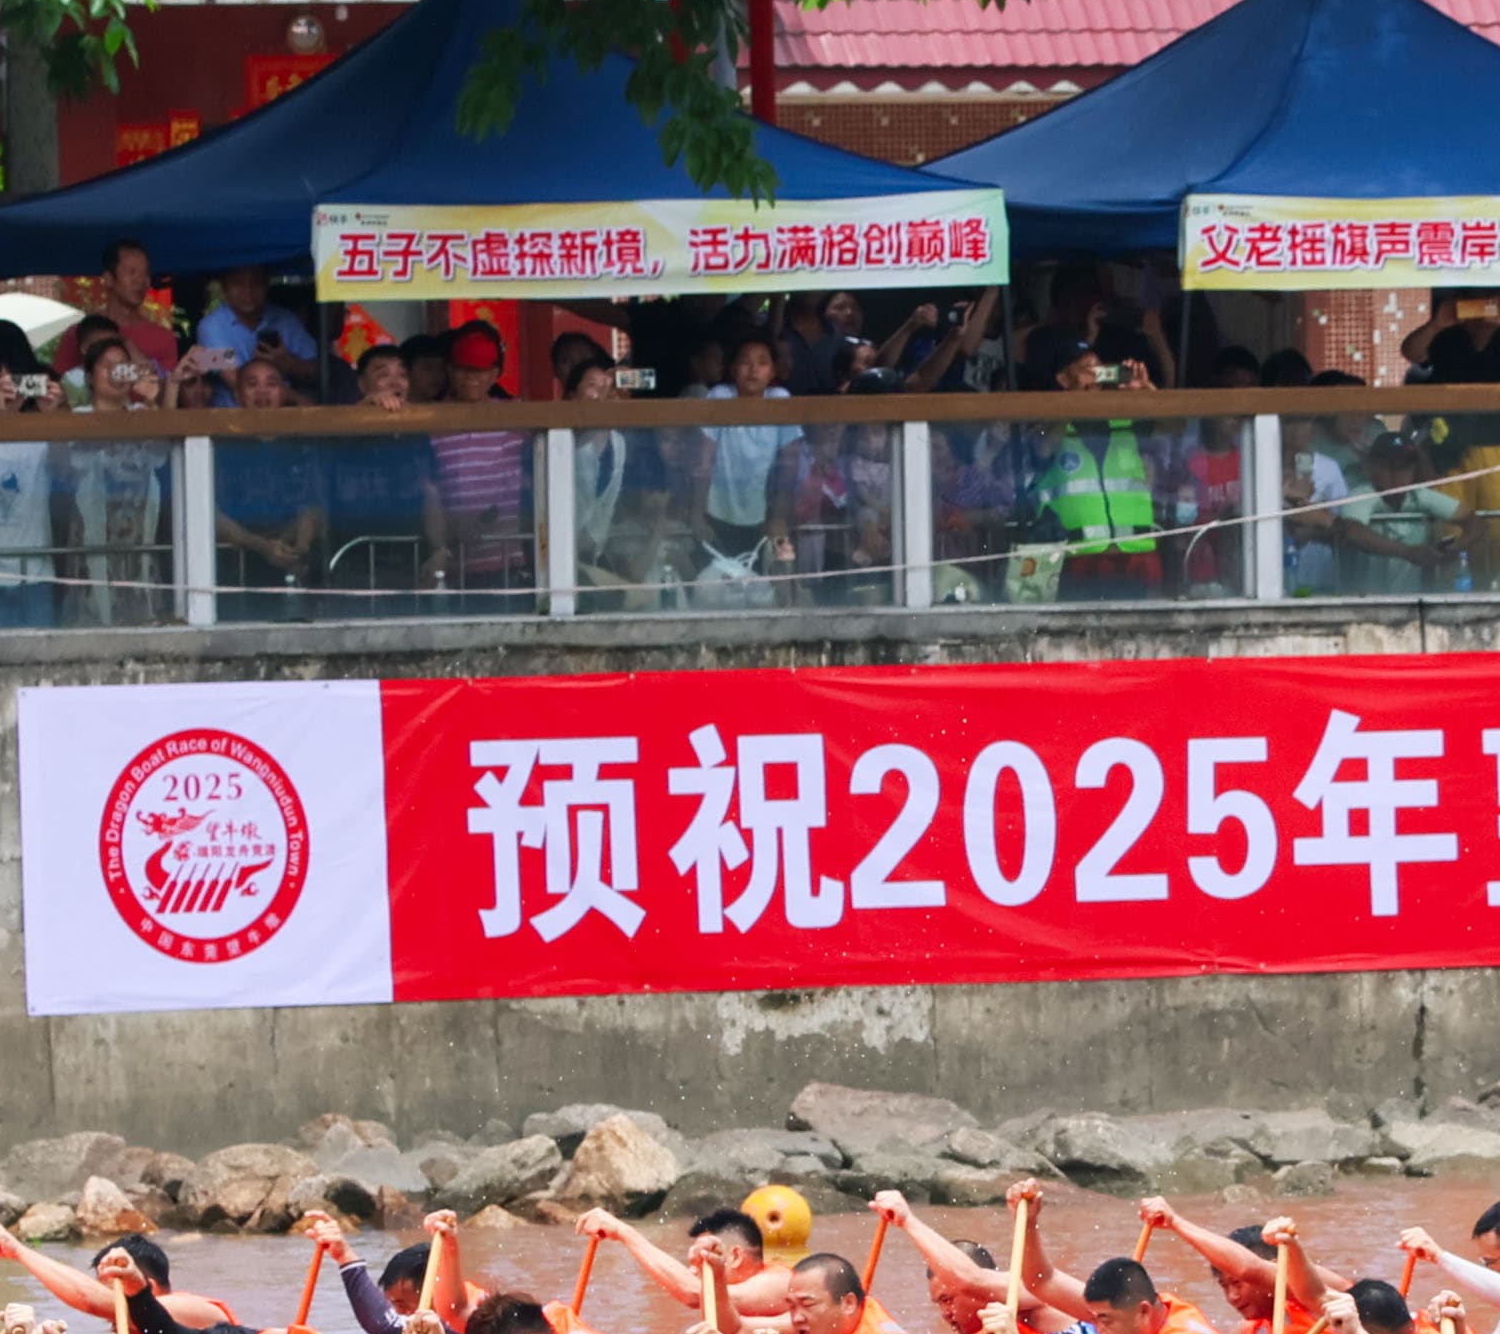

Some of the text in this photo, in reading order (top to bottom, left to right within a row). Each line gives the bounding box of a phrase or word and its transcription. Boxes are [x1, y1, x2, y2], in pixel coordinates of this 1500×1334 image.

[337, 218, 990, 279] 五子不虚探新境，活力满格创巅峰
[105, 736, 305, 881] The Dragon Boat Race of Wangniudun Town
[162, 772, 243, 802] 2025
